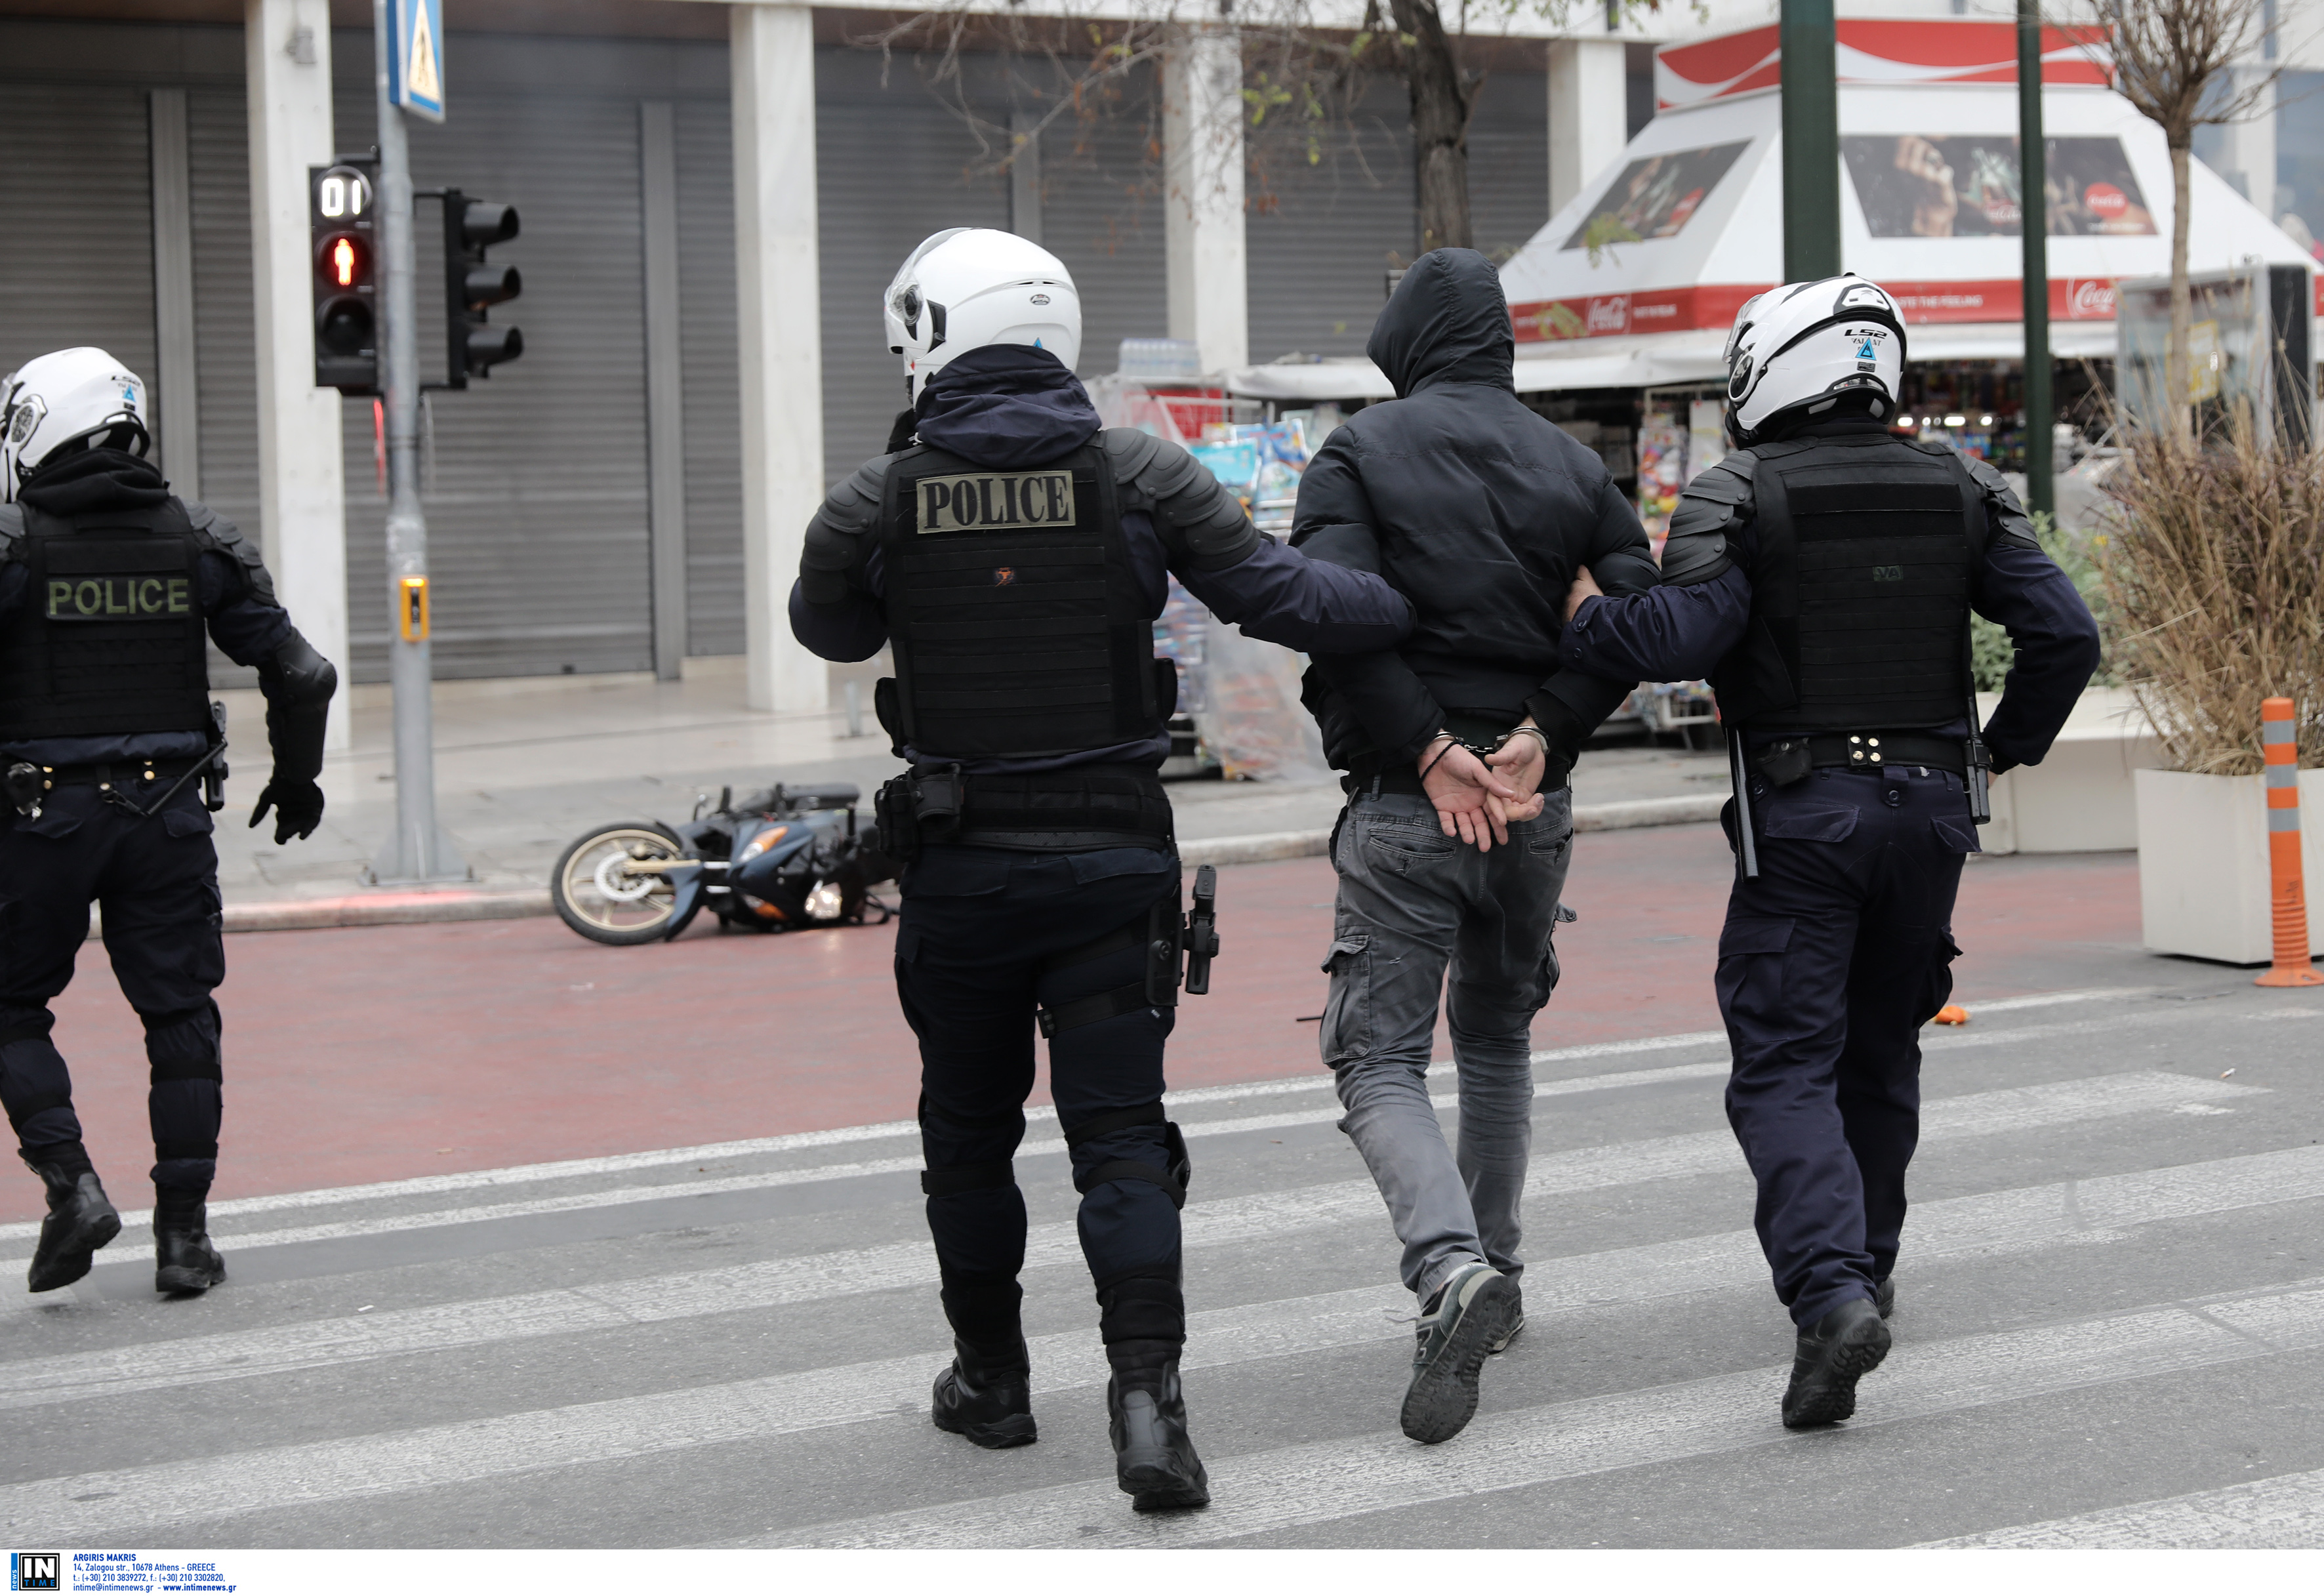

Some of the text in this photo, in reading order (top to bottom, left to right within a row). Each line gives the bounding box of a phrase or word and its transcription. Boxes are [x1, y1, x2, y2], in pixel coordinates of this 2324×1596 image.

[321, 178, 361, 216] 01
[1844, 329, 1888, 340] LS2
[923, 476, 1070, 529] POLICE
[49, 579, 189, 615] POLICE
